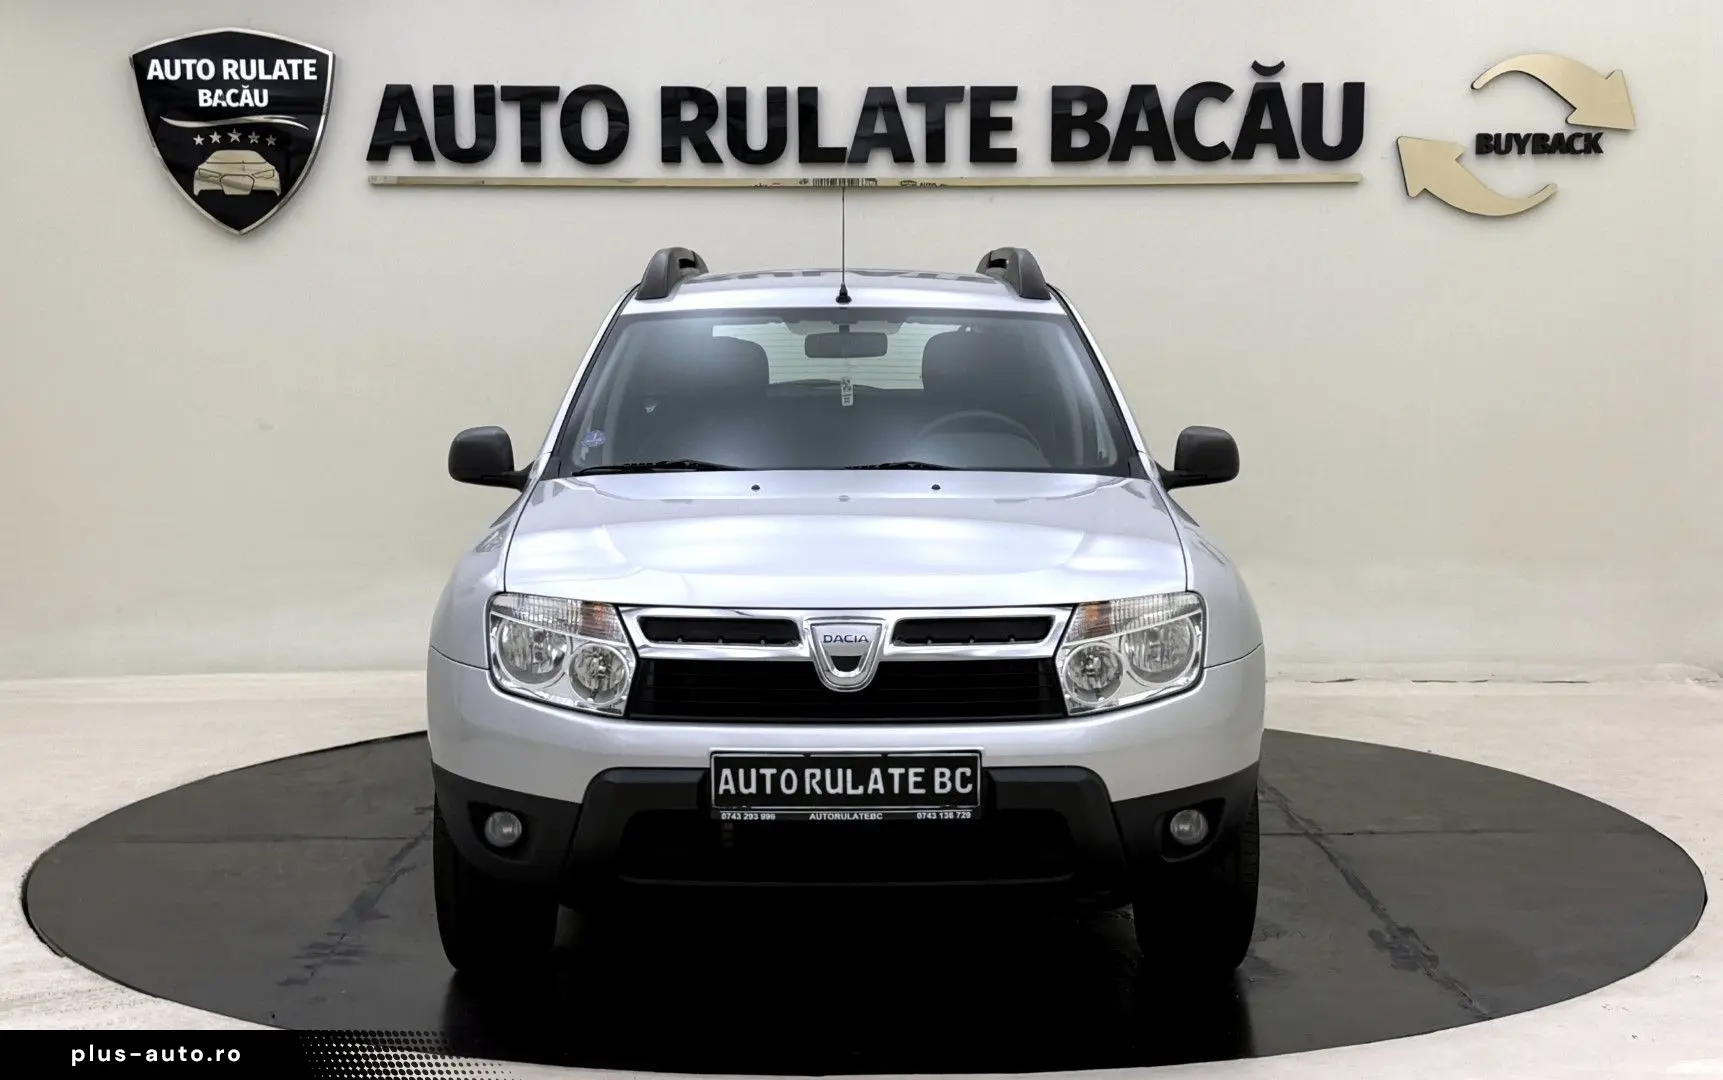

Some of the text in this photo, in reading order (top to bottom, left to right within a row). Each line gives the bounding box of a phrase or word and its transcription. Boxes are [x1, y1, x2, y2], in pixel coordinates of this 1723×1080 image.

[147, 59, 317, 80] AUTO RULATE
[198, 84, 269, 108] BACĂU
[366, 60, 1365, 164] AUTO RULATE BACĂU
[1475, 132, 1604, 155] BUYBACK
[823, 634, 869, 643] DACIA
[718, 767, 973, 795] AUTO RULATE BC
[721, 812, 742, 820] 0743
[809, 812, 883, 820] AUTORULATEBC
[916, 812, 937, 820] 0743
